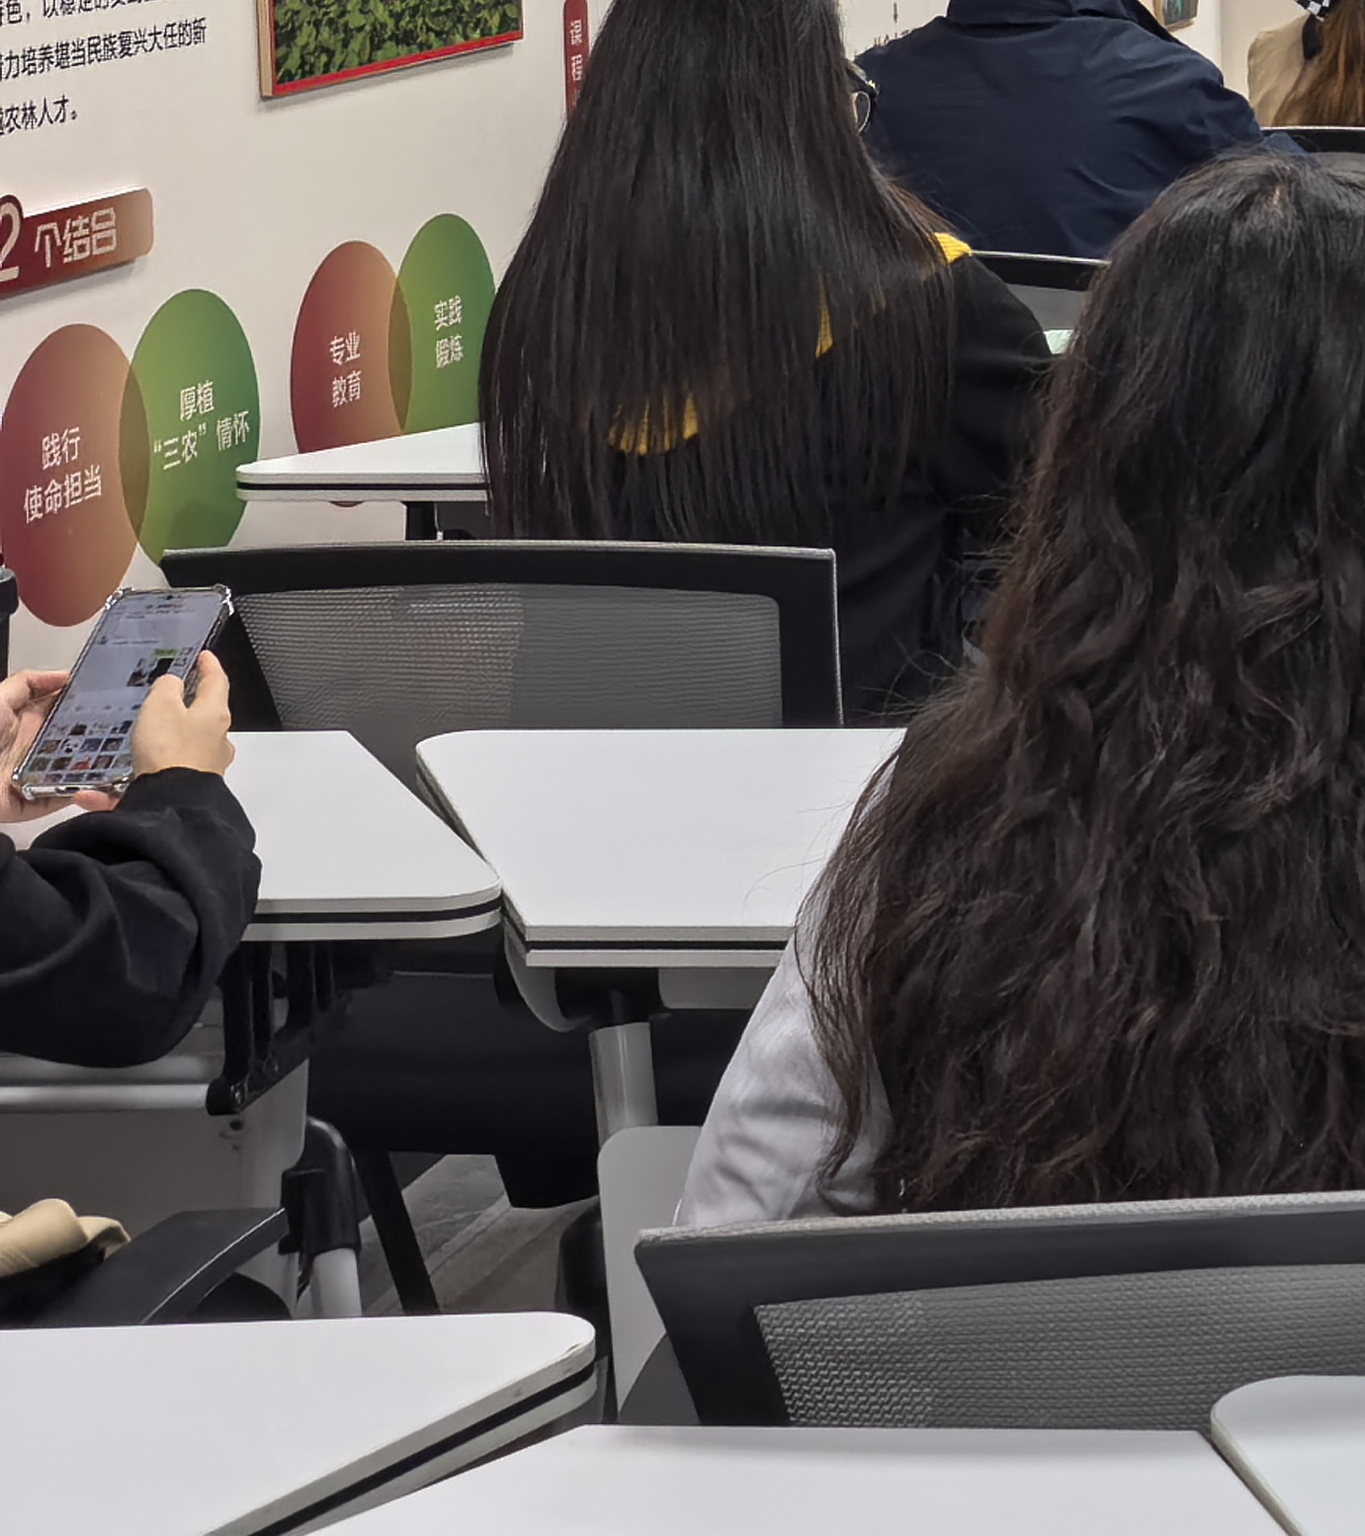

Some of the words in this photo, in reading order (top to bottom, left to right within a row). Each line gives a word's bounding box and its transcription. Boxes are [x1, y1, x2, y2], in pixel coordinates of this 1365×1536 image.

[0, 17, 207, 81] 力培养堪当民族复兴大任的新
[0, 94, 77, 136] 农林人才。
[434, 295, 463, 331] 实践
[330, 330, 361, 366] 专业
[436, 334, 464, 370] 锻炼
[180, 380, 214, 422] 厚植
[332, 370, 362, 408] 教育
[41, 426, 81, 471] 践行
[154, 411, 251, 470] “三农”情怀
[24, 465, 103, 525] 使命担当
